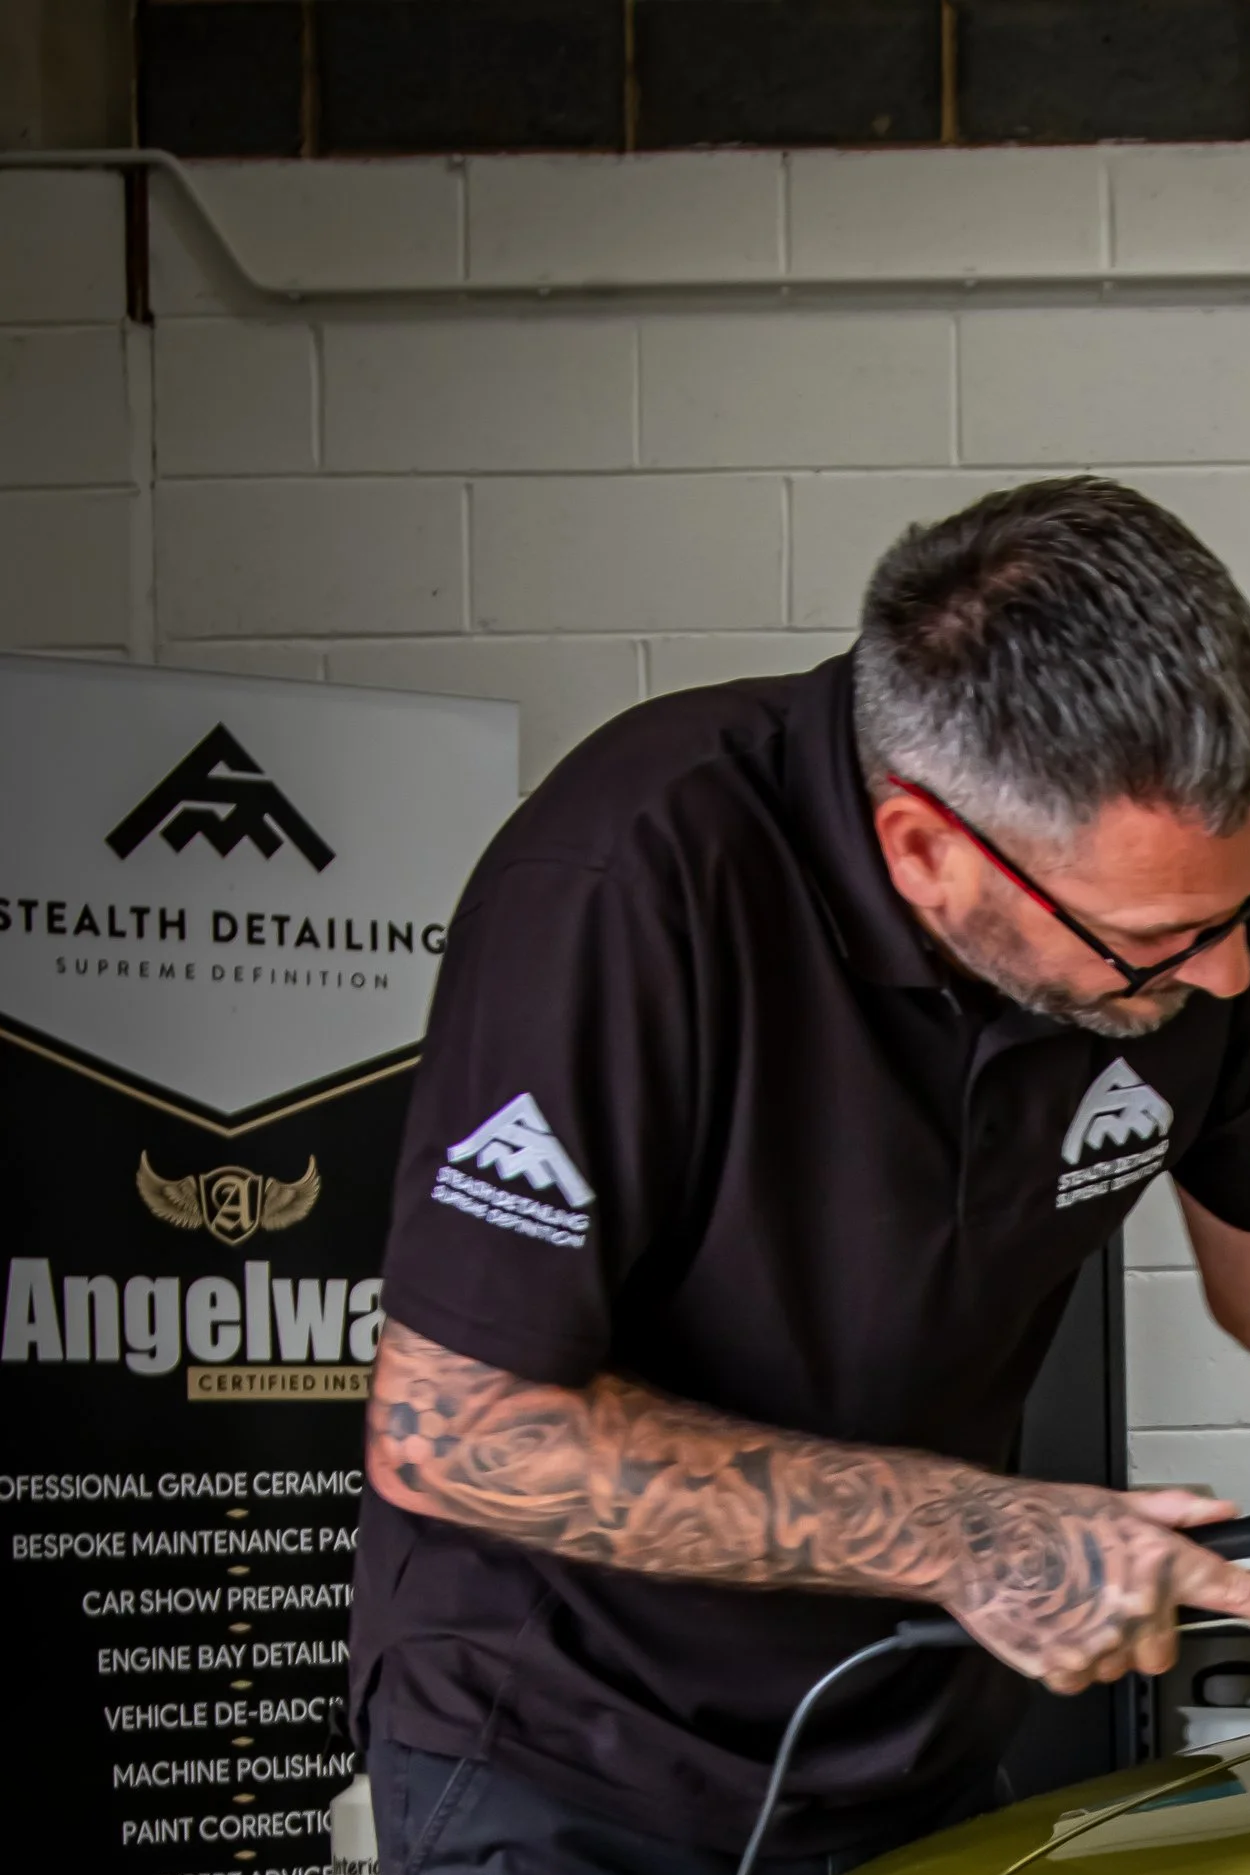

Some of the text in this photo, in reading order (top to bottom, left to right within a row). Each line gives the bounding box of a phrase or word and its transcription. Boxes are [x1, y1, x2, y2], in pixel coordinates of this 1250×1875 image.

[211, 908, 448, 955] DETAILING
[55, 956, 390, 990] SUPREME DEFINITION
[197, 1372, 317, 1394] CERTIFIED
[157, 1471, 248, 1499] GRADE
[252, 1469, 363, 1498] CERAMIC
[12, 1531, 127, 1560] BESPOKE
[132, 1527, 314, 1556] MAINTENANCE
[82, 1583, 354, 1616] CAR SHOW PREPARATI
[98, 1647, 192, 1675] ENGINE
[198, 1643, 247, 1670] BAY
[104, 1702, 208, 1732] VEHICLE
[112, 1758, 230, 1789] MACHINE
[122, 1818, 194, 1846] PAINT
